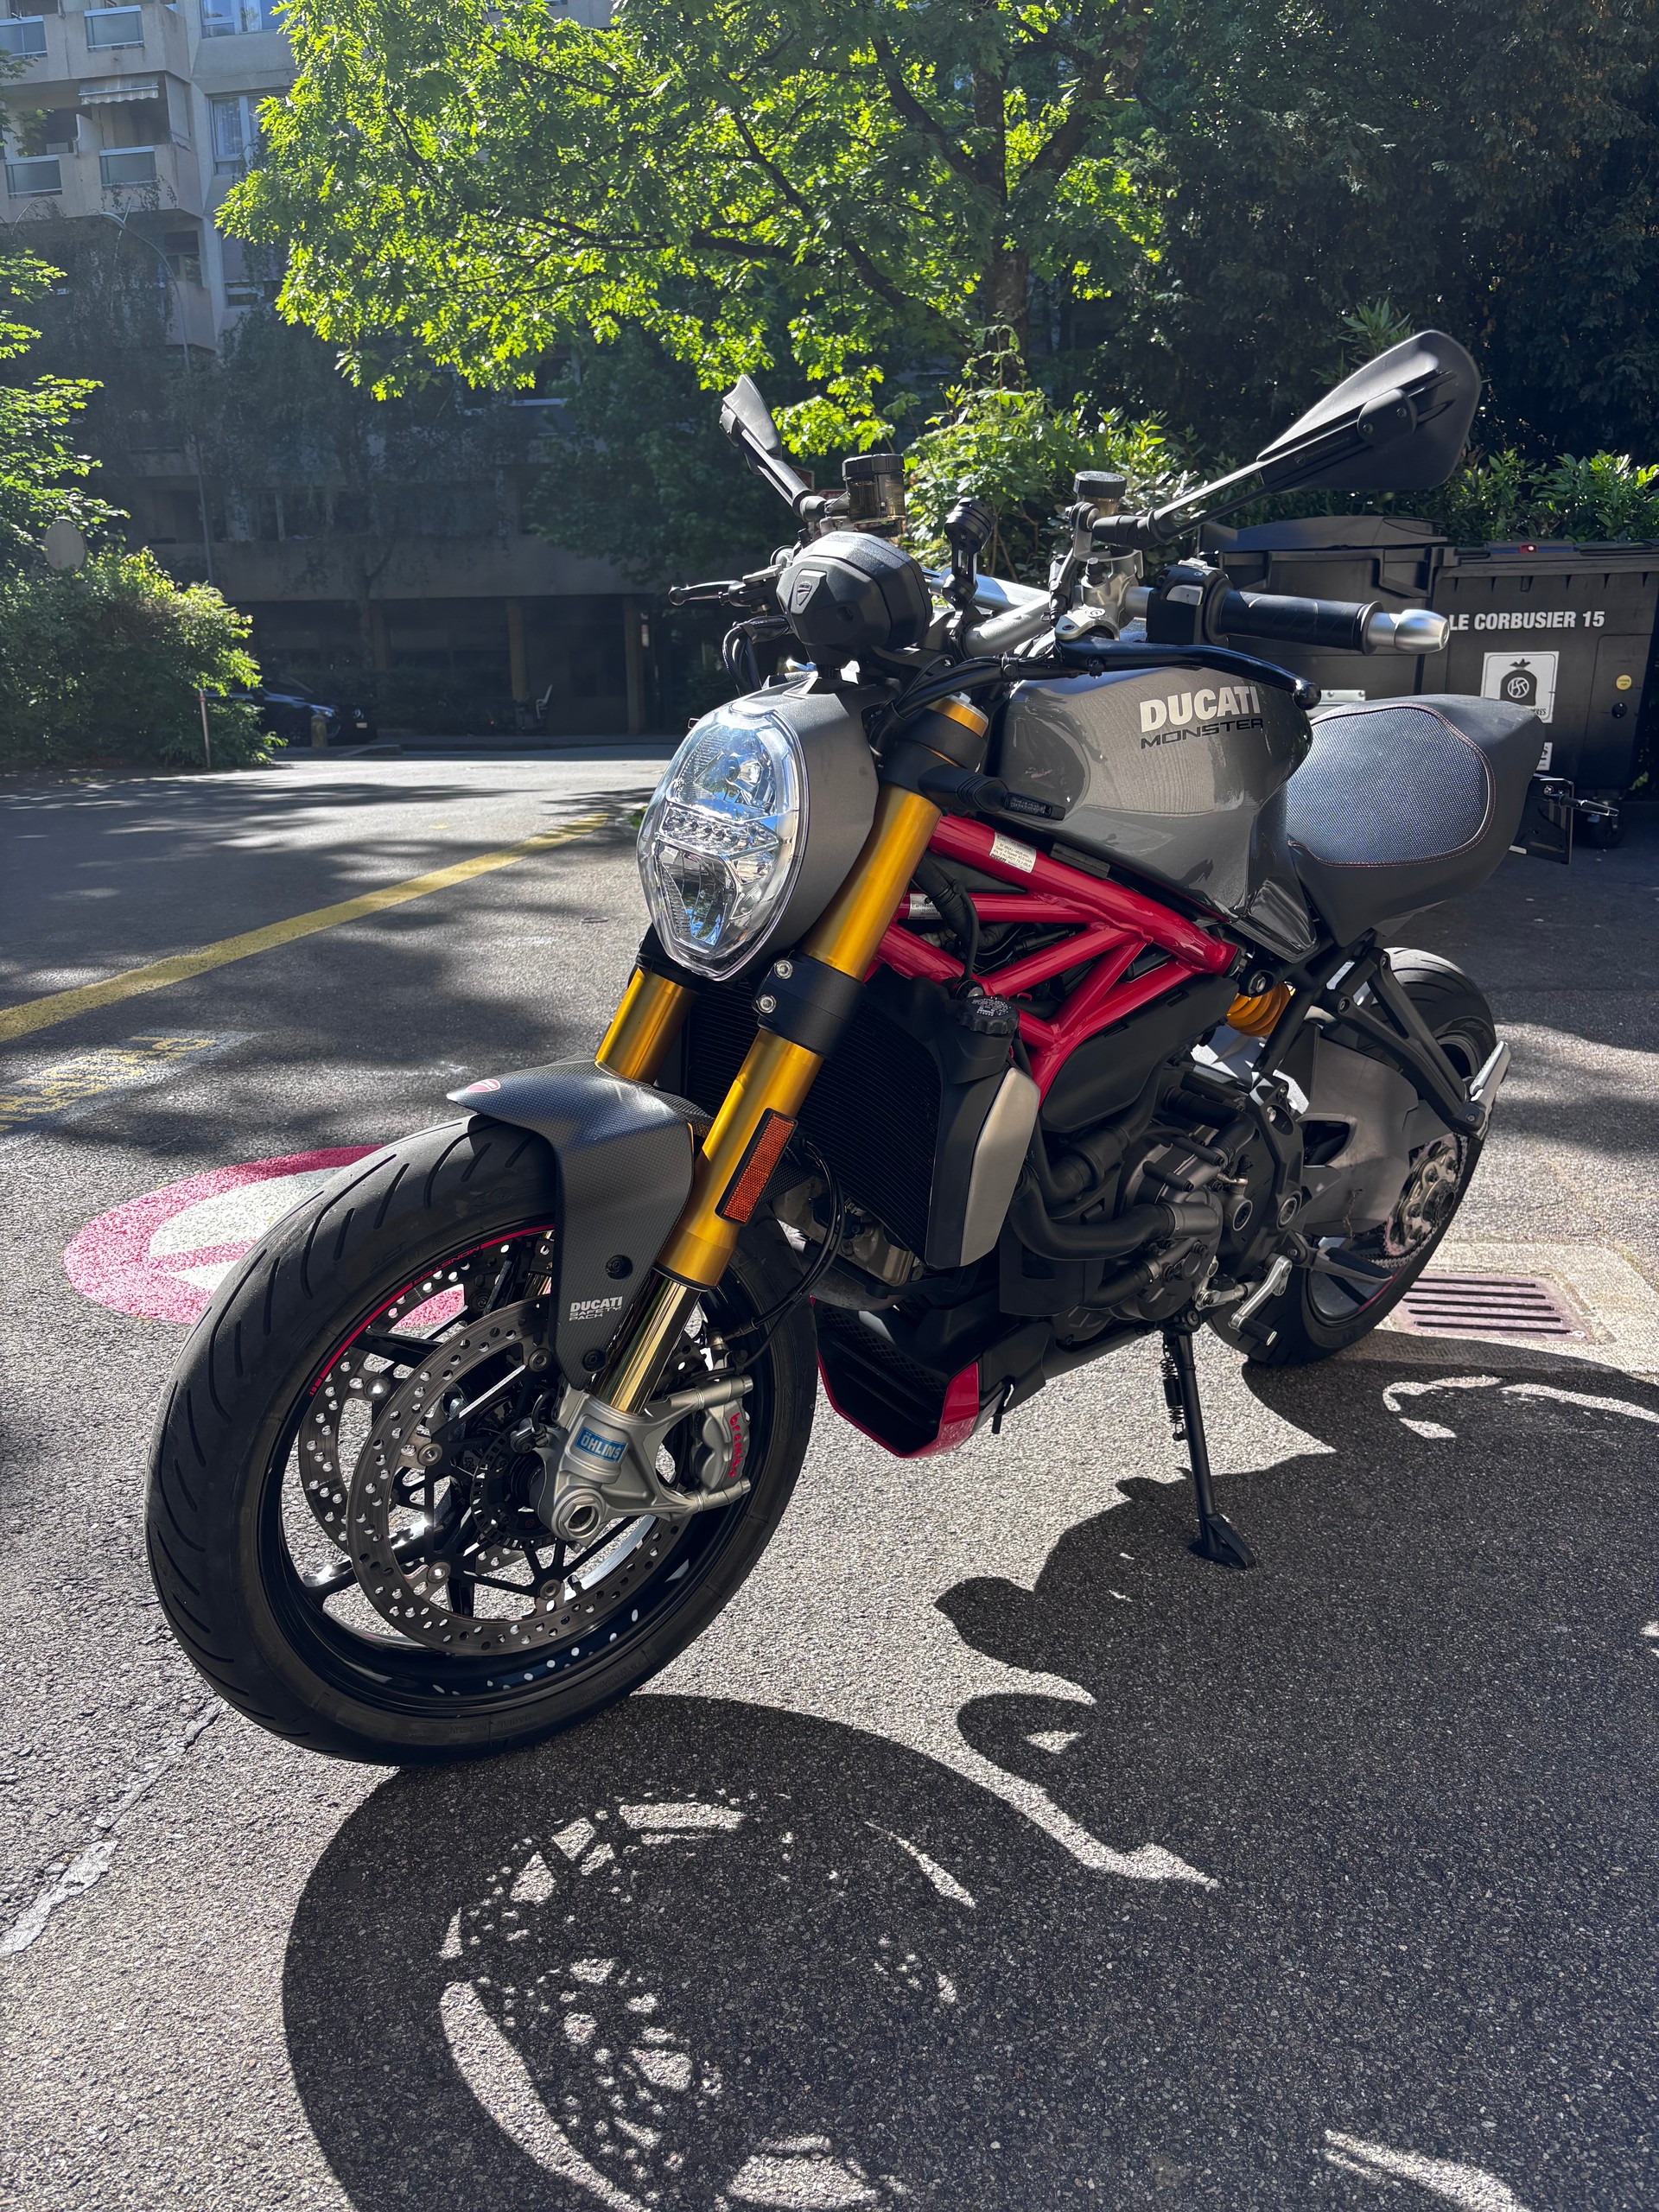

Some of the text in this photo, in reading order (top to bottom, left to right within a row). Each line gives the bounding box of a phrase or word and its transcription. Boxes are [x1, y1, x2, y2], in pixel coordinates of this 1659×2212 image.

[1448, 611, 1605, 632] LE CORBUSIER 15
[1140, 686, 1261, 733] DUCATI
[1141, 718, 1264, 750] MONSTER
[569, 1306, 621, 1317] SAFETY
[570, 1296, 622, 1312] DUCATI
[580, 1431, 622, 1459] ÖHLINS
[728, 1412, 742, 1478] brembo
